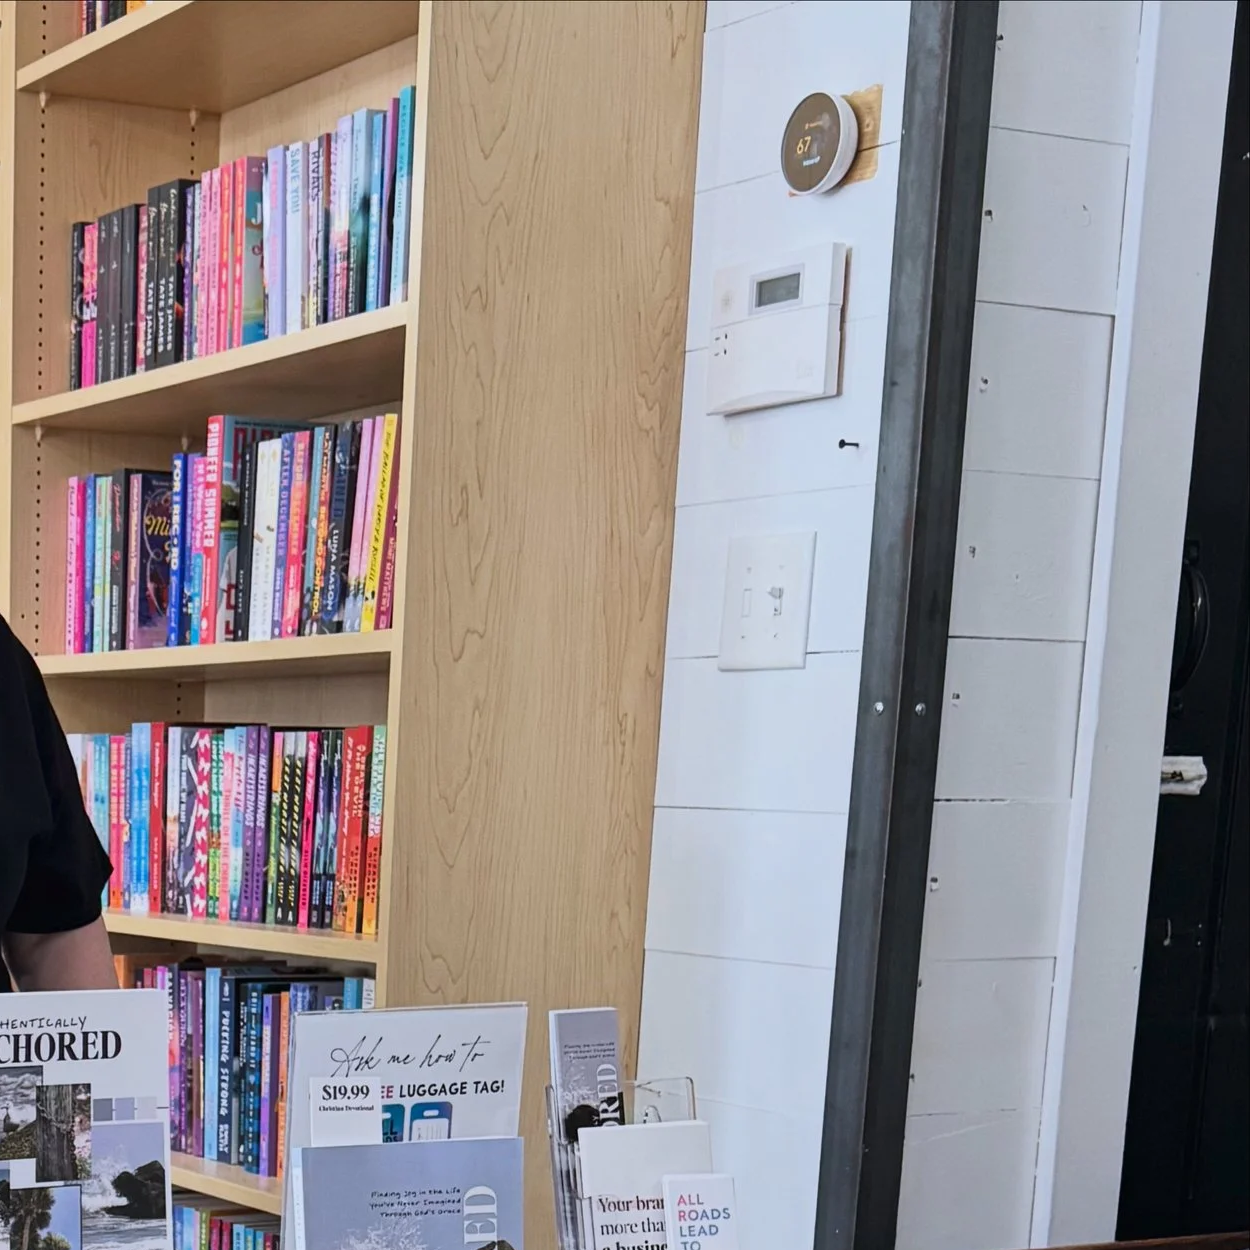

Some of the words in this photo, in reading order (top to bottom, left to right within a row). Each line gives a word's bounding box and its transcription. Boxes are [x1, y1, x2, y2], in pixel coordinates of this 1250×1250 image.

[795, 135, 812, 155] 67
[290, 146, 300, 183] SAVE
[310, 149, 322, 203] RIVALS
[167, 275, 176, 305] TATE
[157, 309, 166, 354] JAMES
[166, 305, 175, 352] JAMES
[330, 529, 340, 566] LUNA
[326, 567, 337, 612] MASON
[330, 1034, 383, 1077] Ask
[387, 1053, 416, 1066] me
[419, 1033, 457, 1069] how
[460, 1035, 492, 1073] to
[322, 1084, 370, 1101] $19.99
[399, 1080, 468, 1099] LUGGAGE
[472, 1079, 505, 1095] TAG!
[370, 1189, 401, 1199] Finding
[423, 1198, 461, 1207] Imagined
[677, 1193, 704, 1207] ALL
[597, 1197, 633, 1213] Your
[678, 1207, 731, 1222] ROADS
[600, 1220, 638, 1236] more
[679, 1224, 719, 1237] LEAD
